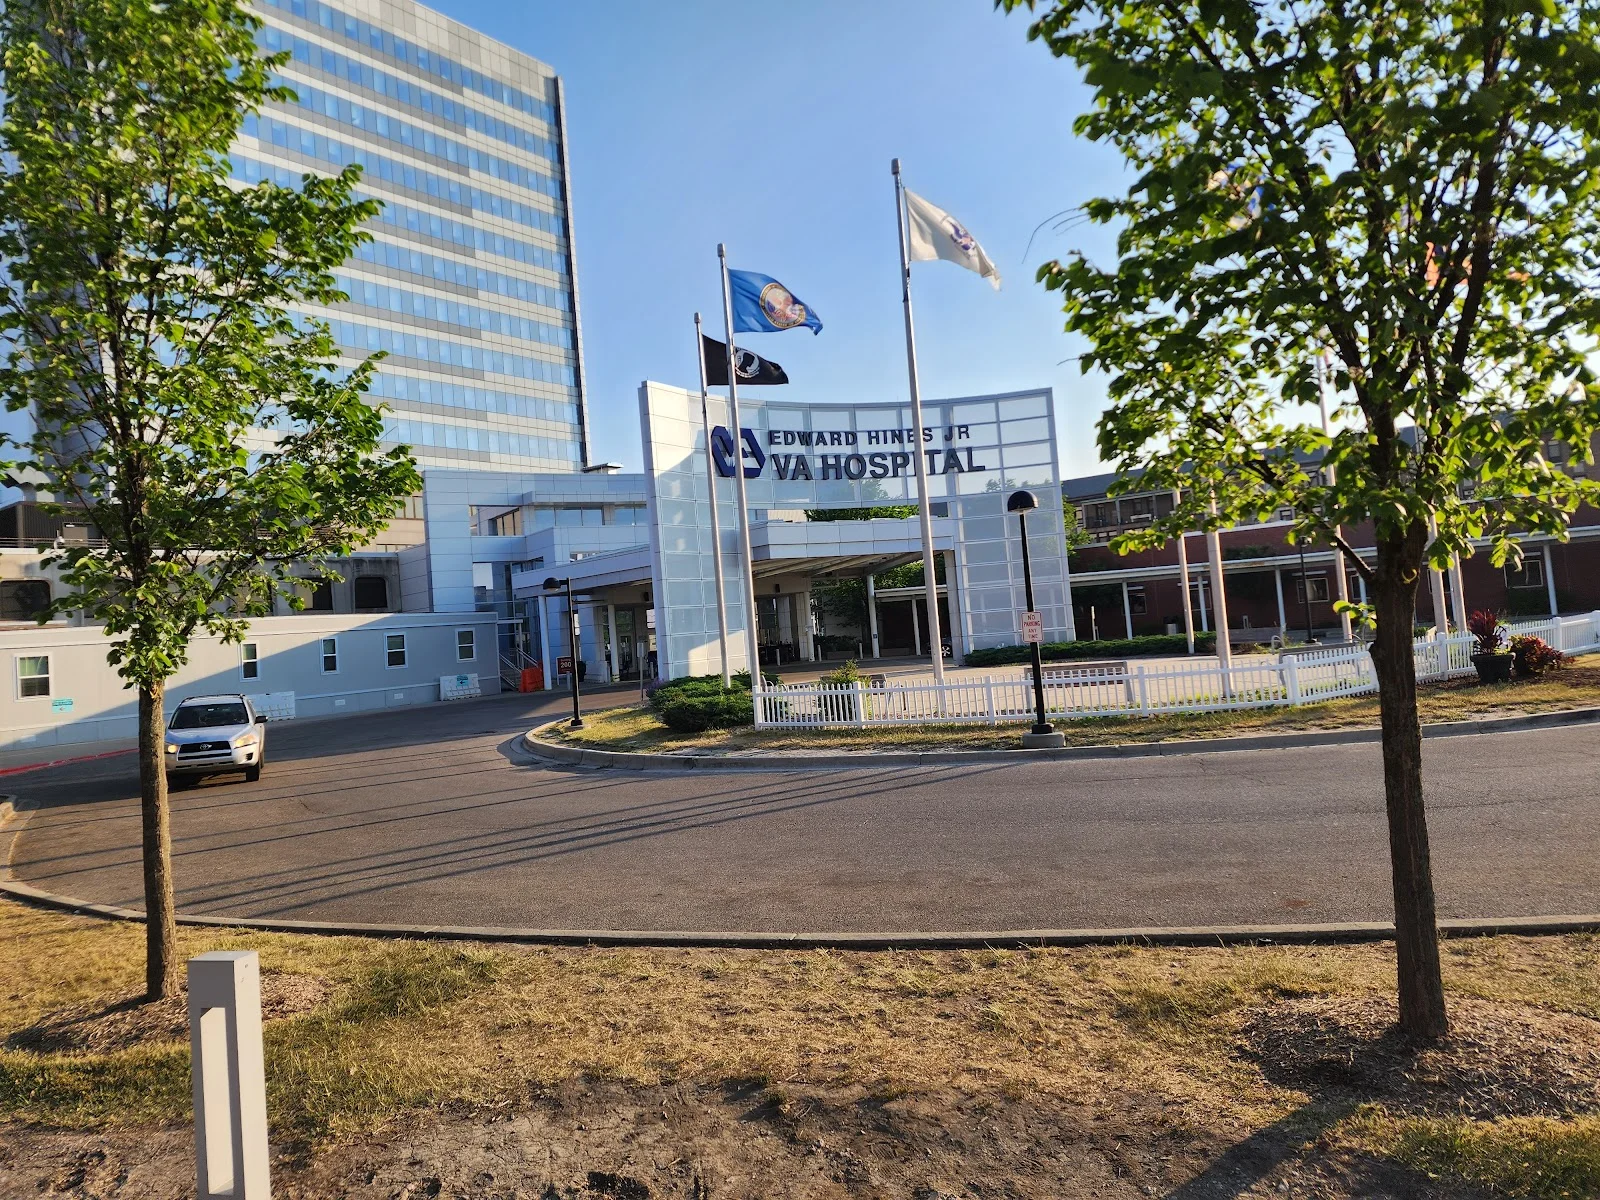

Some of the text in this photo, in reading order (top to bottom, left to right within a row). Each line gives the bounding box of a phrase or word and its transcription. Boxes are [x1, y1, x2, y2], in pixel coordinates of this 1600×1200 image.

[769, 424, 970, 447] EDWARD HINES JR
[772, 453, 814, 480] VA
